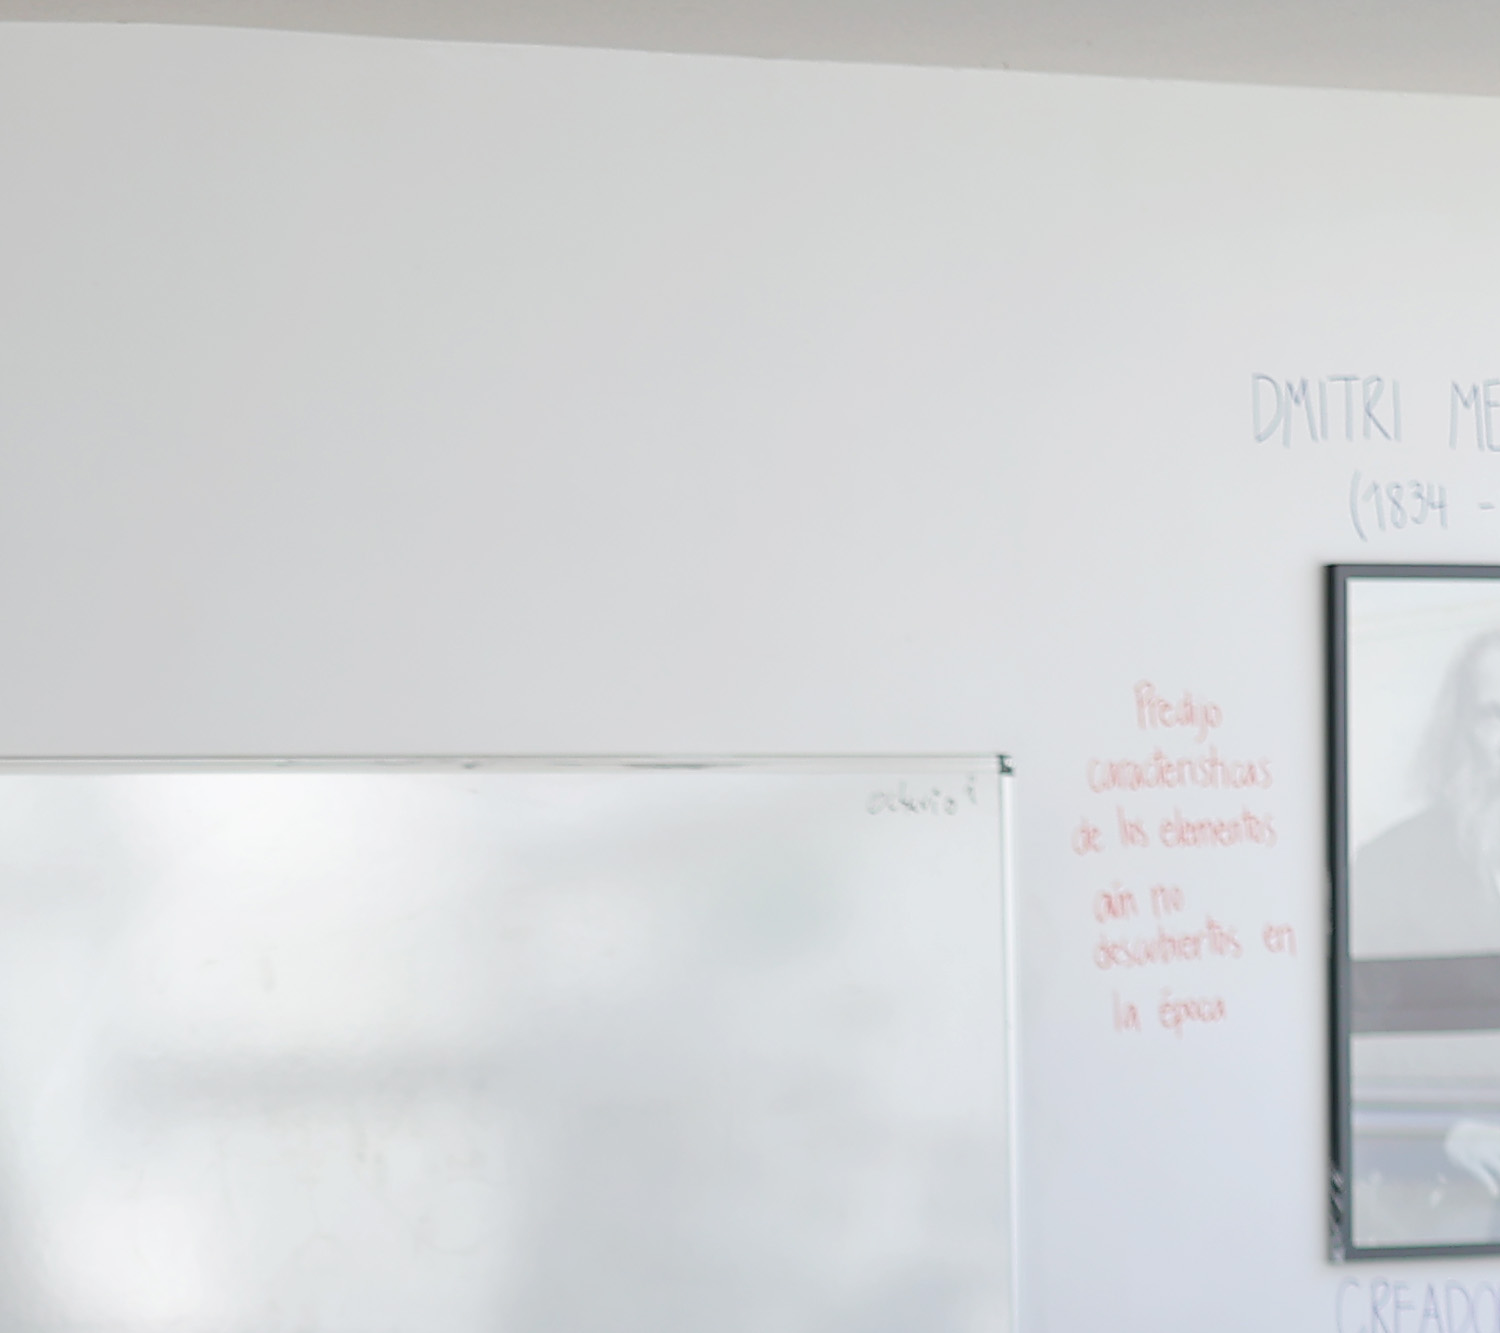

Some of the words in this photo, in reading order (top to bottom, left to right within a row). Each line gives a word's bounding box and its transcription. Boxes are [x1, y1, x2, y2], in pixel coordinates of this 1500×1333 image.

[1250, 372, 1402, 449] DMITRI
[1348, 469, 1449, 542] (1834
[1071, 815, 1104, 857] de
[1115, 804, 1149, 848] los
[1159, 804, 1278, 848] elementos
